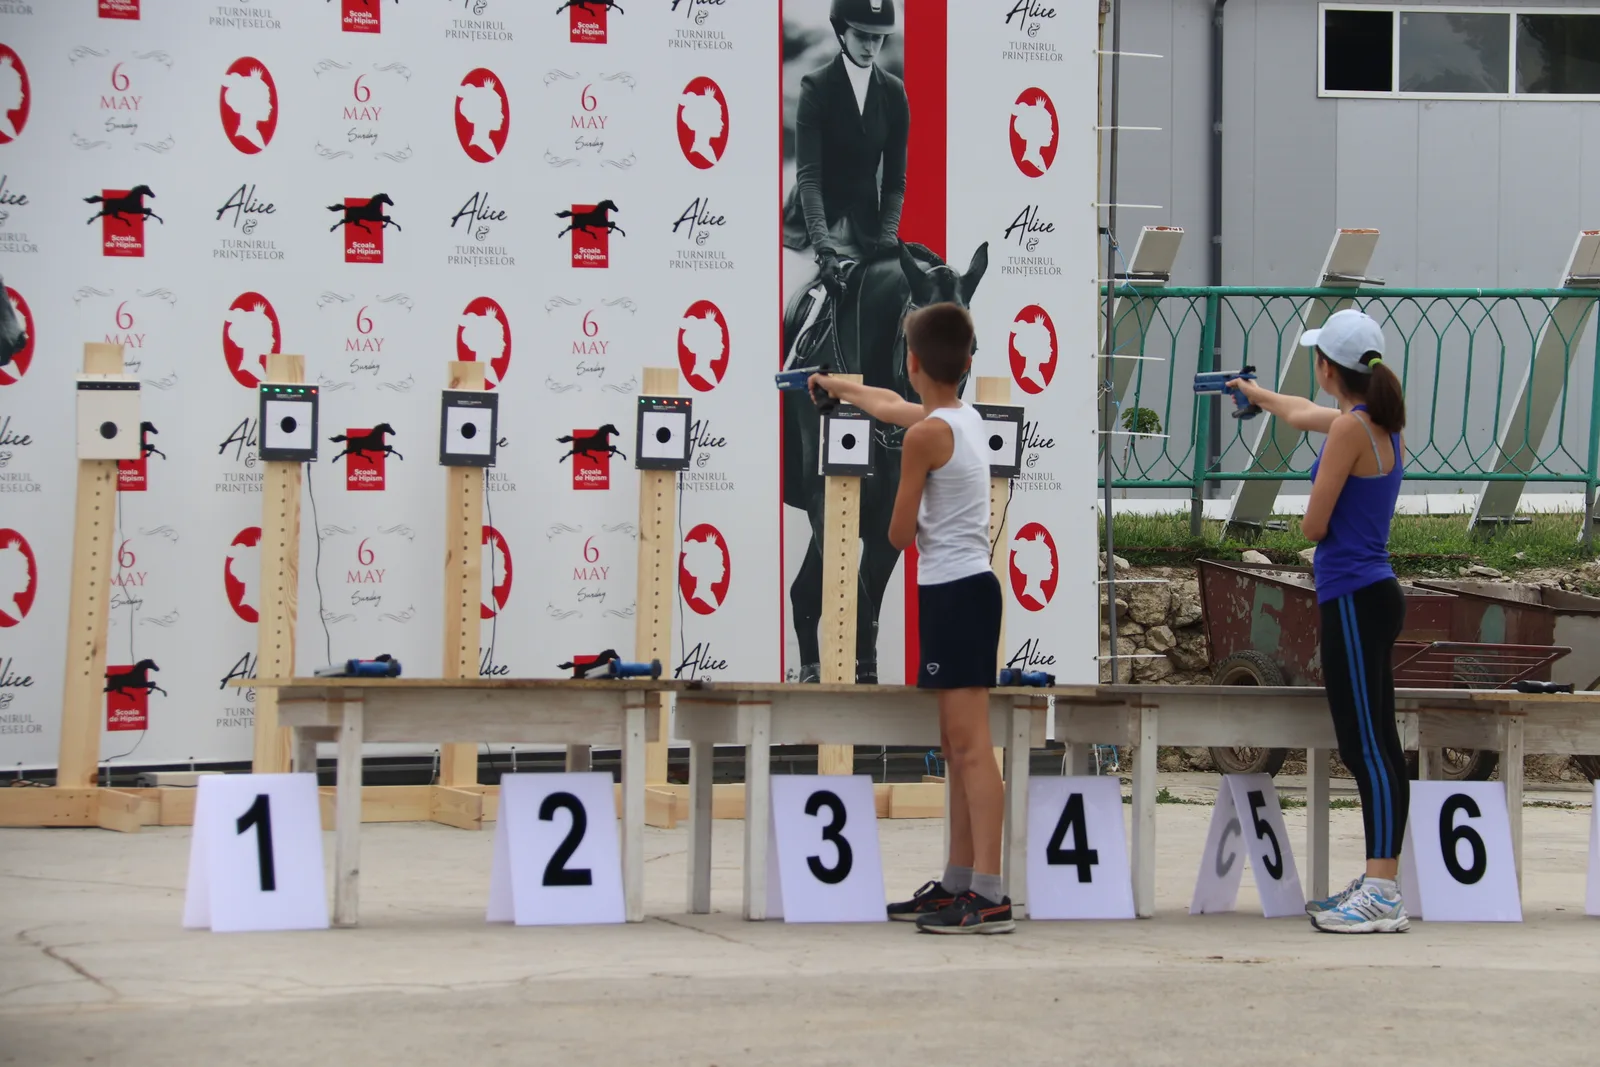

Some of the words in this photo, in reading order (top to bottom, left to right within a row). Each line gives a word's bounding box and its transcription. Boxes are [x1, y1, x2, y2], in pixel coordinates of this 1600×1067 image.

[217, 7, 273, 18] TURNIRUL
[694, 10, 708, 26] &
[453, 19, 506, 30] TURNIRUL
[582, 28, 605, 36] Hipism
[1027, 22, 1040, 38] &
[676, 29, 726, 40] TURNIRUL
[1009, 41, 1056, 52] TURNIRUL
[112, 62, 130, 92] 6
[354, 74, 370, 102] 6
[100, 96, 143, 111] MAY
[581, 84, 597, 112] 6
[343, 106, 382, 121] MAY
[570, 115, 608, 130] MAY
[347, 127, 378, 146] Sunday
[574, 136, 604, 153] Sunday
[216, 183, 276, 228] Alice
[450, 191, 508, 234] Alice
[242, 218, 258, 235] &
[672, 197, 727, 240] Alice
[1004, 204, 1056, 246] Alice
[475, 226, 490, 242] &
[695, 230, 710, 246] &
[220, 239, 276, 250] TURNIRUL
[455, 245, 508, 256] TURNIRUL
[1026, 238, 1040, 252] &
[584, 252, 606, 261] Hipism
[676, 250, 726, 260] TURNIRUL
[1008, 256, 1055, 266] TURNIRUL
[115, 300, 134, 330] 6
[356, 306, 373, 334] 6
[582, 309, 598, 338] 6
[104, 333, 146, 348] MAY
[345, 338, 384, 352] MAY
[572, 340, 610, 354] MAY
[350, 358, 380, 376] Sunday
[576, 360, 605, 378] Sunday
[696, 452, 710, 468] &
[1026, 452, 1040, 468] &
[359, 474, 383, 483] Hipism
[584, 474, 608, 482] Hipism
[118, 538, 136, 568] 6
[358, 537, 375, 566] 6
[583, 535, 600, 564] 6
[346, 569, 386, 584] MAY
[572, 566, 610, 580] MAY
[351, 590, 382, 608] Sunday
[577, 587, 606, 604] Sunday
[674, 642, 728, 680] Alice
[1006, 638, 1057, 671] Alice
[236, 794, 276, 892] 1
[538, 791, 592, 887] 2
[804, 790, 853, 885] 3
[1046, 792, 1099, 884] 4
[1246, 790, 1284, 881] 5
[1438, 792, 1488, 886] 6
